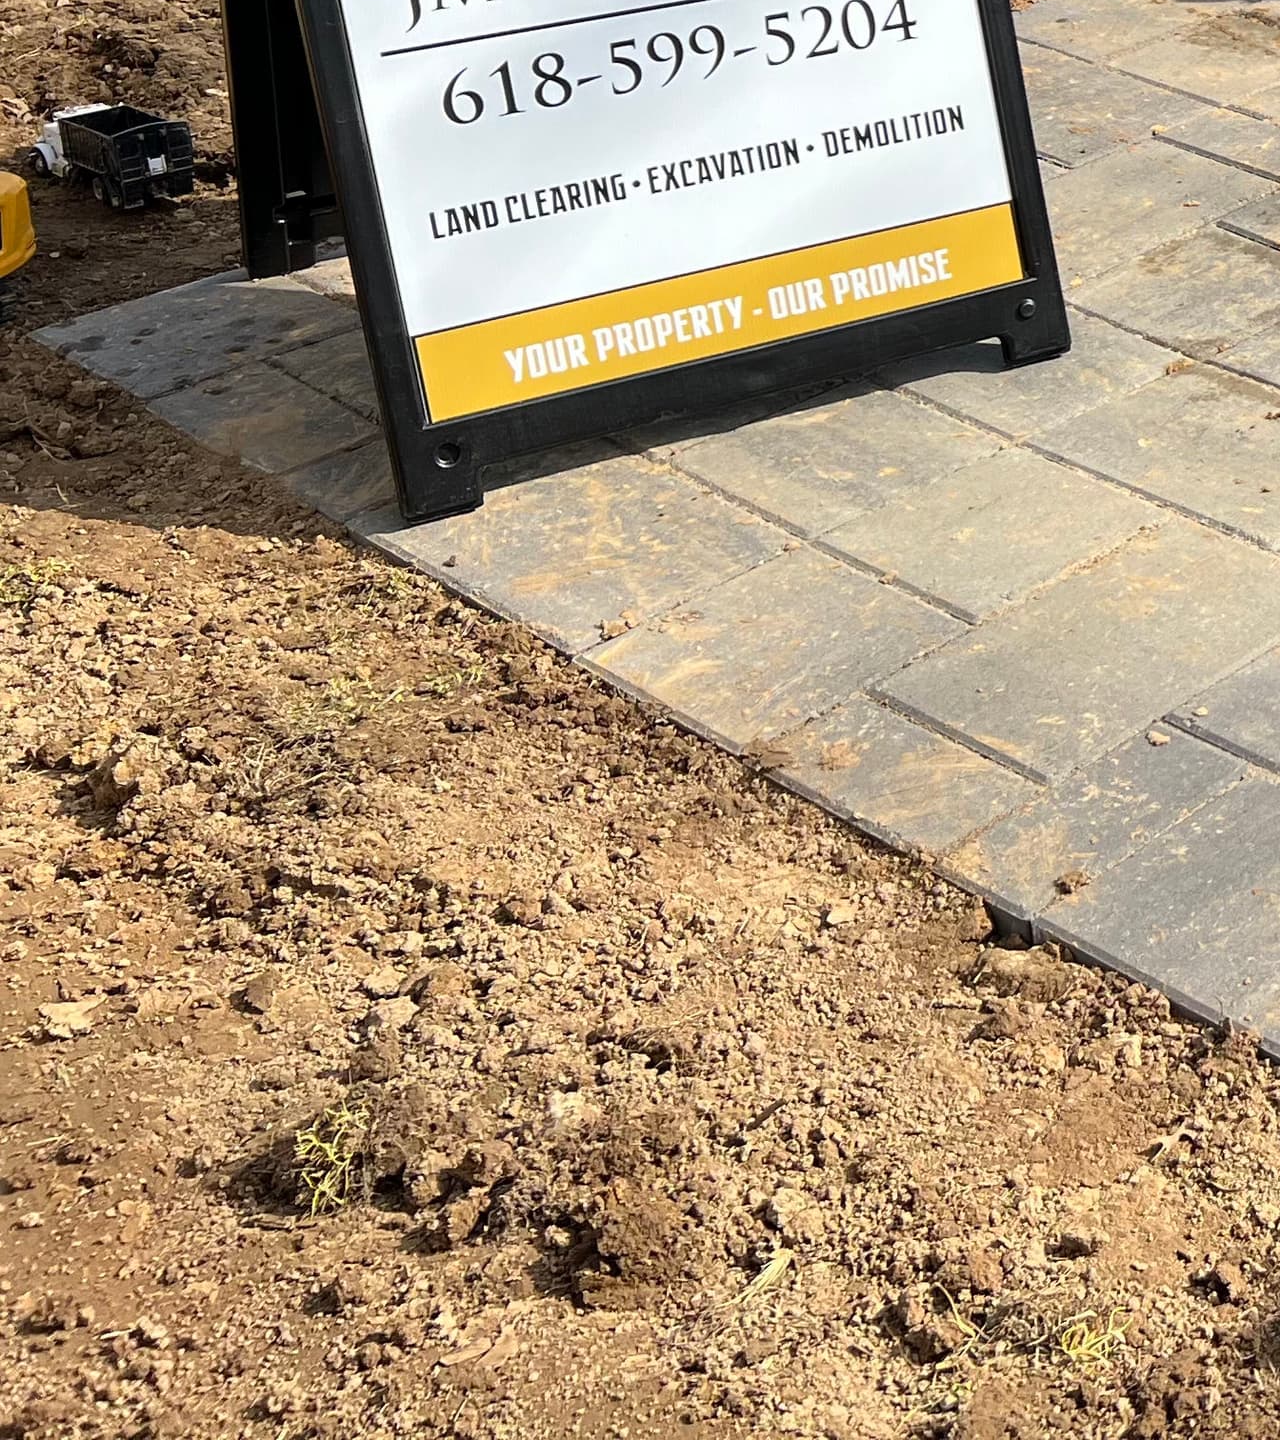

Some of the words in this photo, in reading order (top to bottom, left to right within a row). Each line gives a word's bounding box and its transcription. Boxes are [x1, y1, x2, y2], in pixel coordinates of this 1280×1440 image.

[428, 199, 499, 240] LAND
[504, 172, 627, 224] CLEARING
[646, 137, 801, 195] EXCAVATION
[820, 104, 967, 159] DEMOLITION
[503, 332, 588, 383] YOUR
[591, 295, 745, 362] PROPERTY
[767, 271, 826, 322] OUR
[830, 247, 953, 308] PROMISE
